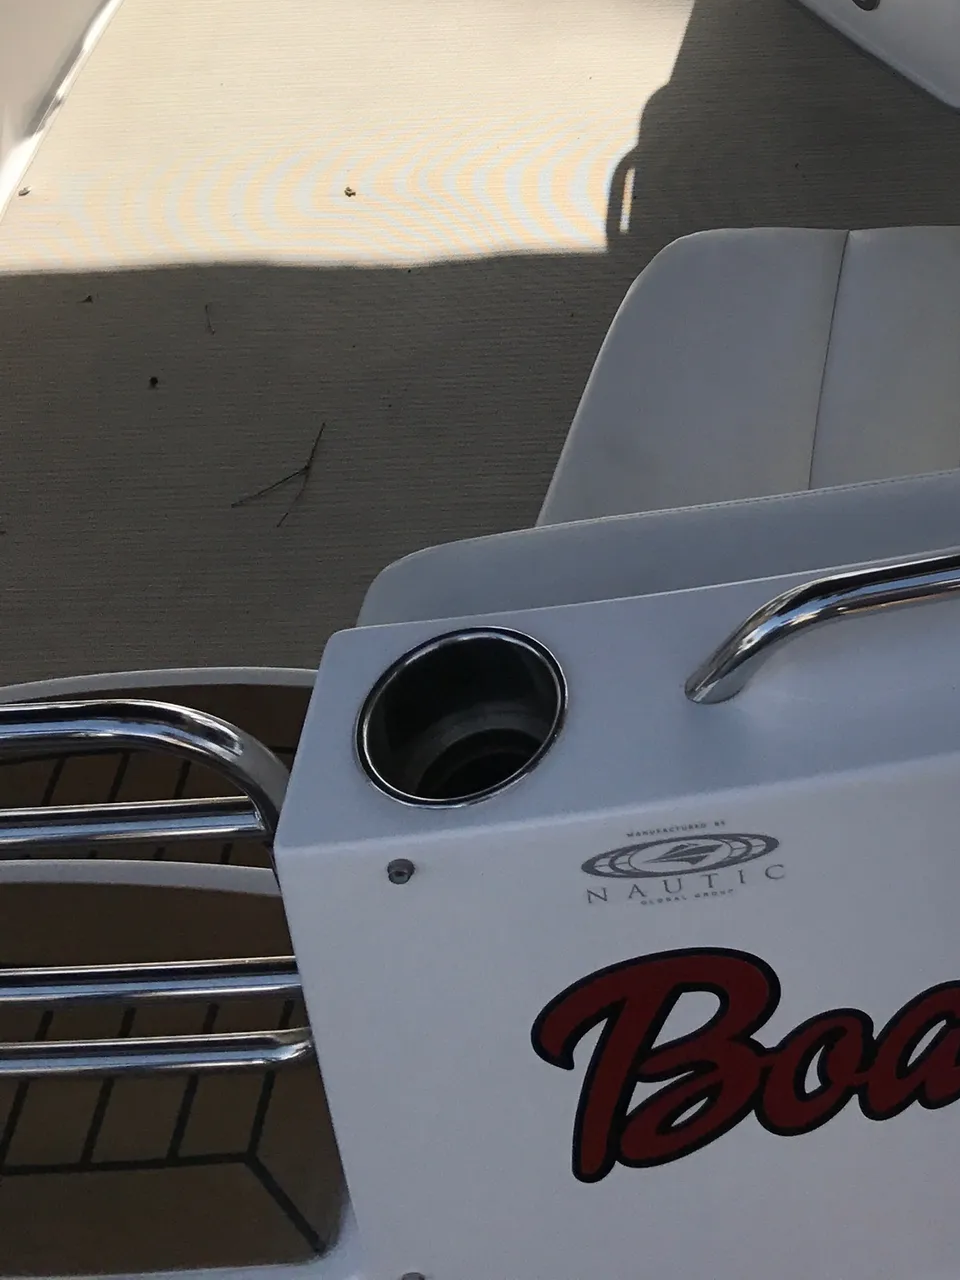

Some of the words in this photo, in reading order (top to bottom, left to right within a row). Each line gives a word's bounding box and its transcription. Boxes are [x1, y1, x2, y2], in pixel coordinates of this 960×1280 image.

[626, 822, 707, 838] MANUFACTURED
[587, 864, 785, 904] NAUTIC
[640, 895, 687, 906] GLOBAL
[694, 888, 734, 899] GROUP
